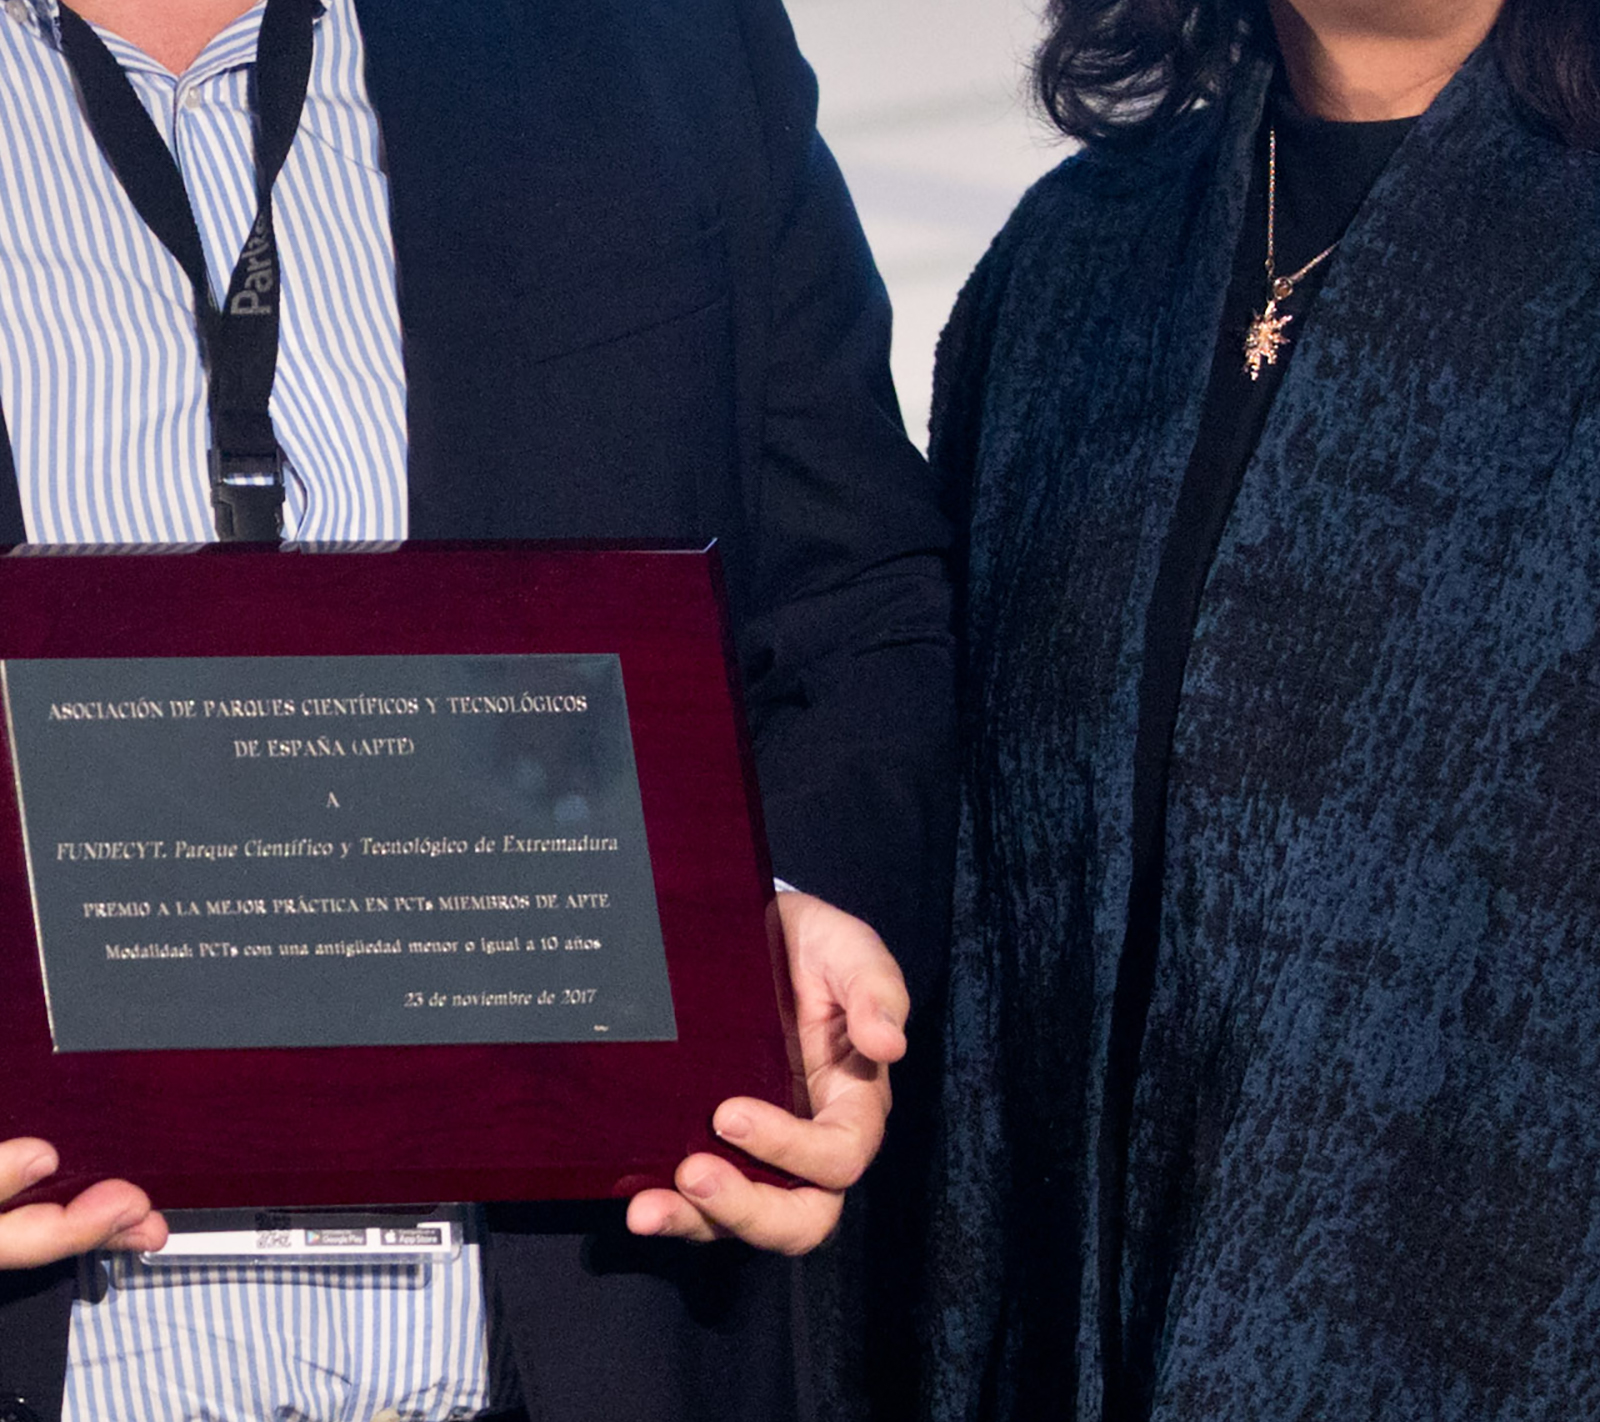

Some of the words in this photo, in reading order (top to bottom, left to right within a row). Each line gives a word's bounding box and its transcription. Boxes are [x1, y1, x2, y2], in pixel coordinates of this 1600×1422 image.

[49, 697, 164, 720] ASOCIACIÓN
[170, 699, 197, 718] DE
[204, 699, 295, 717] PARQUES
[302, 693, 419, 716] CIENTÍFICOS
[425, 698, 438, 714] Y
[447, 692, 588, 713] TECNOLÓGICOS
[234, 739, 260, 757] DE
[267, 736, 346, 757] ESPAÑA
[352, 737, 415, 756] (APTE)
[326, 791, 340, 808] A
[57, 841, 167, 861] FUNDECYT.
[175, 841, 238, 861] Parque
[244, 838, 334, 858] Científico
[339, 841, 353, 858] y
[360, 836, 468, 857] Tecnológico
[474, 836, 496, 853] de
[503, 834, 618, 853] Extremadura
[83, 902, 151, 918] PREMIO
[157, 902, 170, 916] A
[176, 901, 201, 916] LA
[206, 899, 267, 915] MEJOR
[273, 895, 359, 915] PRÁCTICA
[366, 897, 389, 912] EN
[394, 896, 434, 912] PCTs
[439, 894, 530, 910] MIEMBROS
[535, 894, 559, 909] DE
[565, 893, 611, 909] APTE
[105, 943, 193, 960] Modalidad:
[199, 942, 238, 958] PCTs
[243, 944, 273, 956] con
[279, 944, 309, 956] una
[315, 939, 401, 958] antigüedad
[408, 941, 459, 953] menor
[464, 941, 475, 952] o
[481, 937, 520, 955] igual
[526, 939, 536, 951] a
[541, 936, 559, 951] 10
[565, 935, 602, 951] años
[428, 992, 447, 1006] de
[452, 990, 533, 1006] noviembre
[537, 990, 555, 1005] de
[561, 989, 597, 1005] 2017
